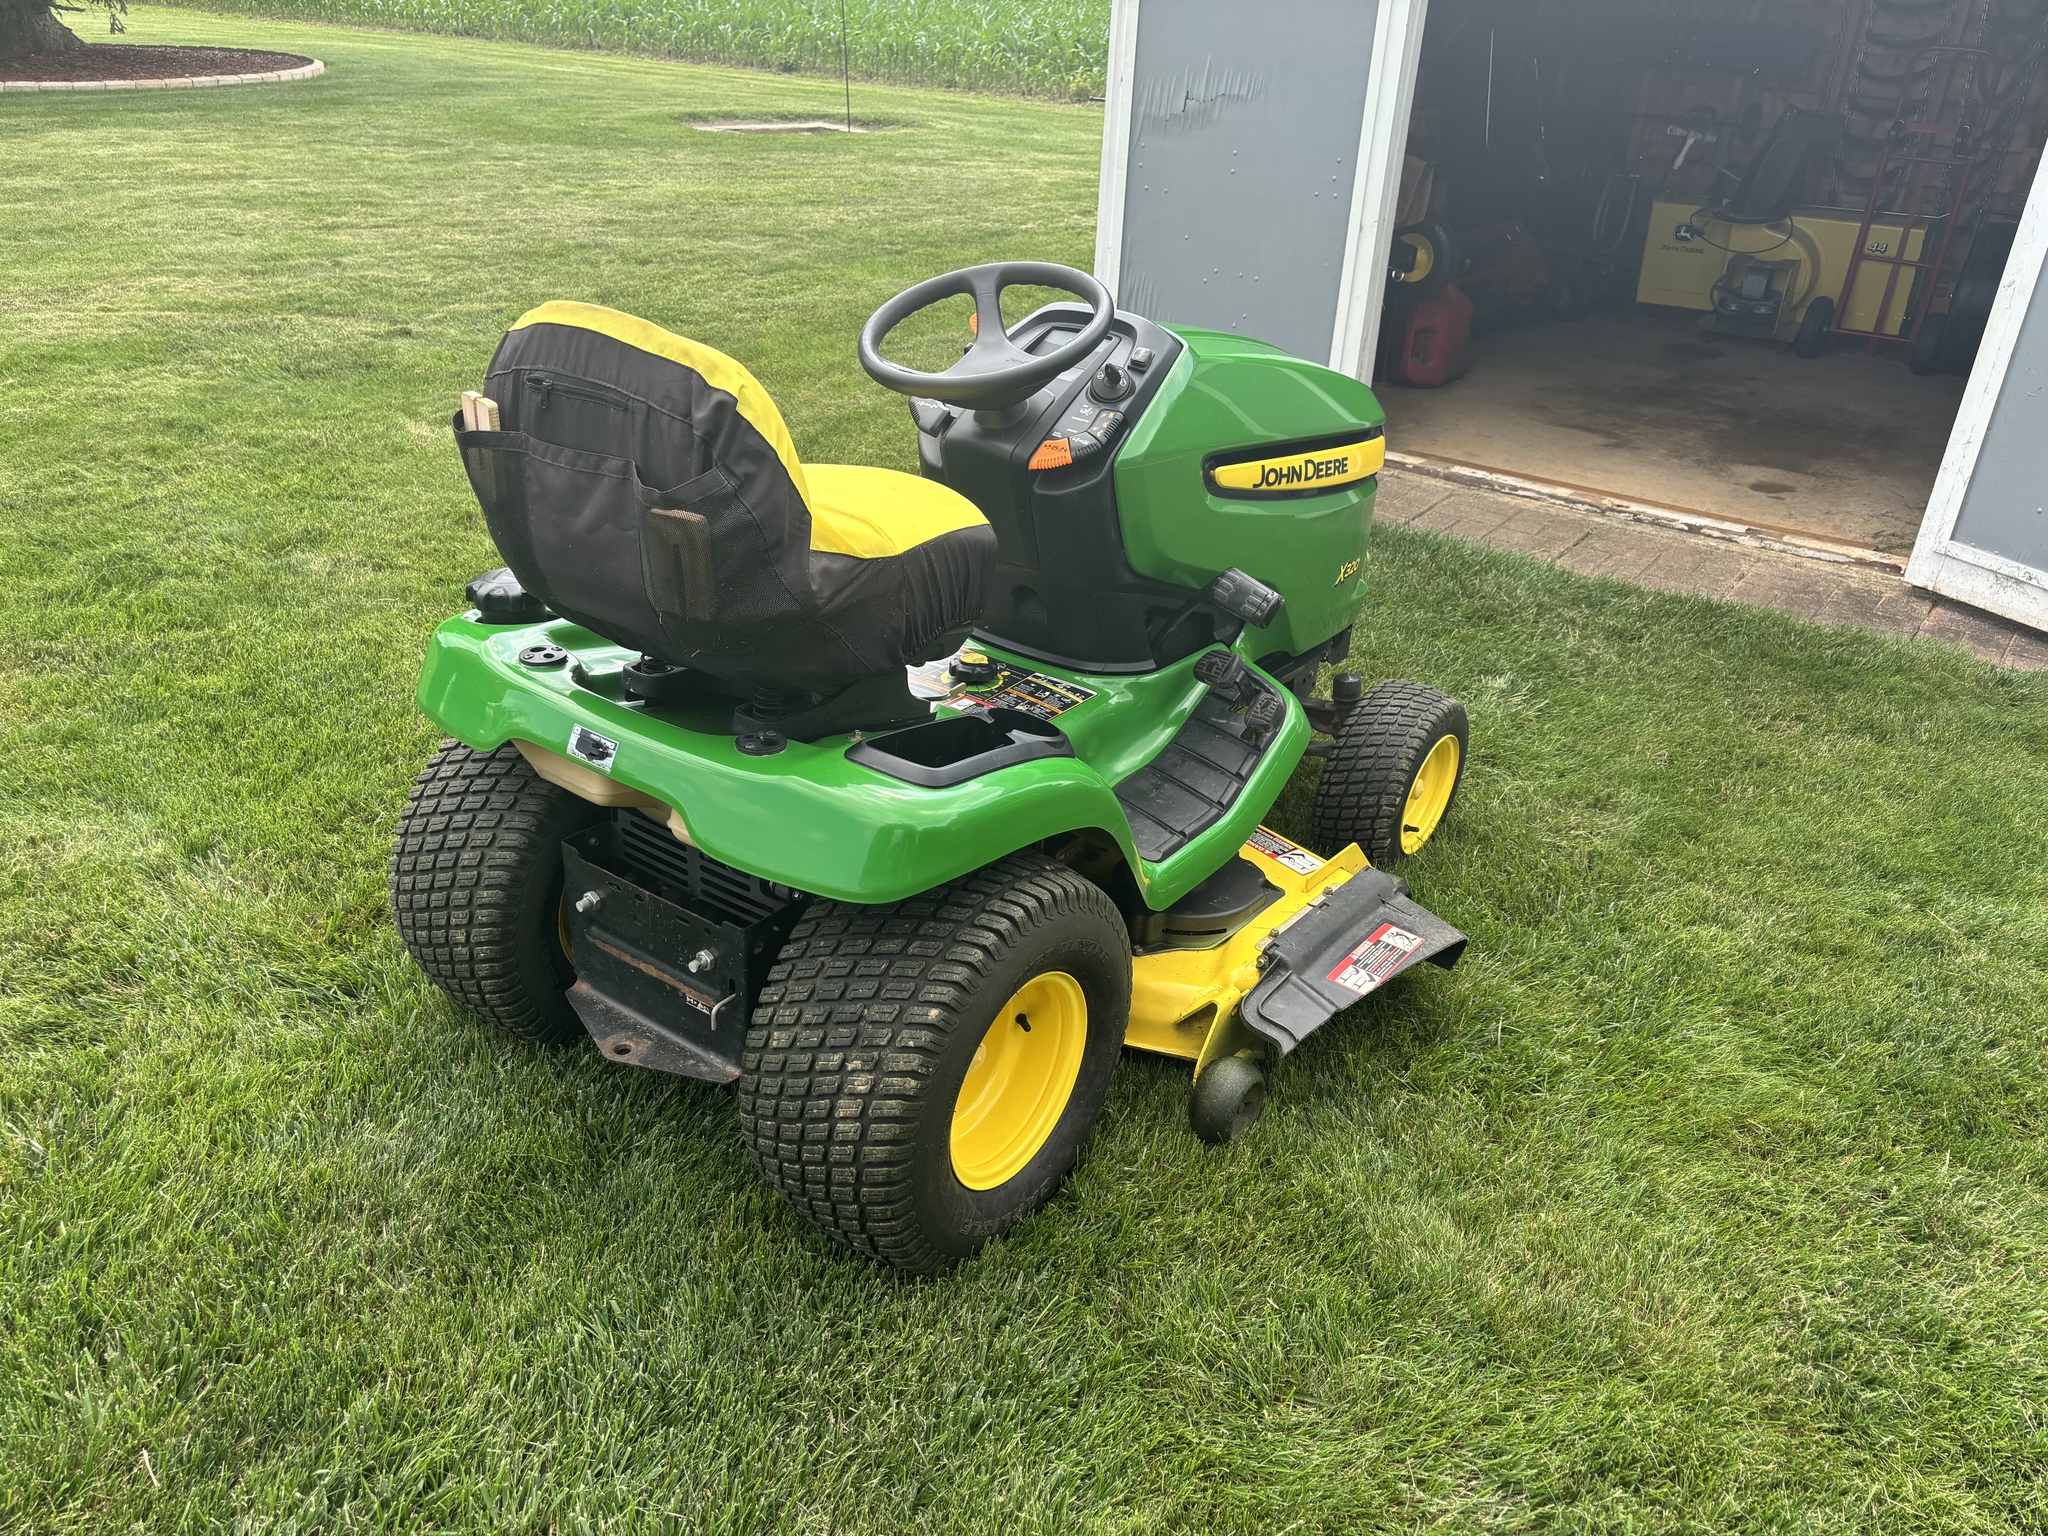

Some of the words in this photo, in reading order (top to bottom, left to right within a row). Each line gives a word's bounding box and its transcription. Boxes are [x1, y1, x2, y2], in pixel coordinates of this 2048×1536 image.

[1660, 244, 1679, 252] JOHN
[1680, 245, 1704, 254] DEERE
[1867, 241, 1888, 254] 44
[1252, 464, 1302, 489] JOHN
[1304, 456, 1349, 481] DEERE
